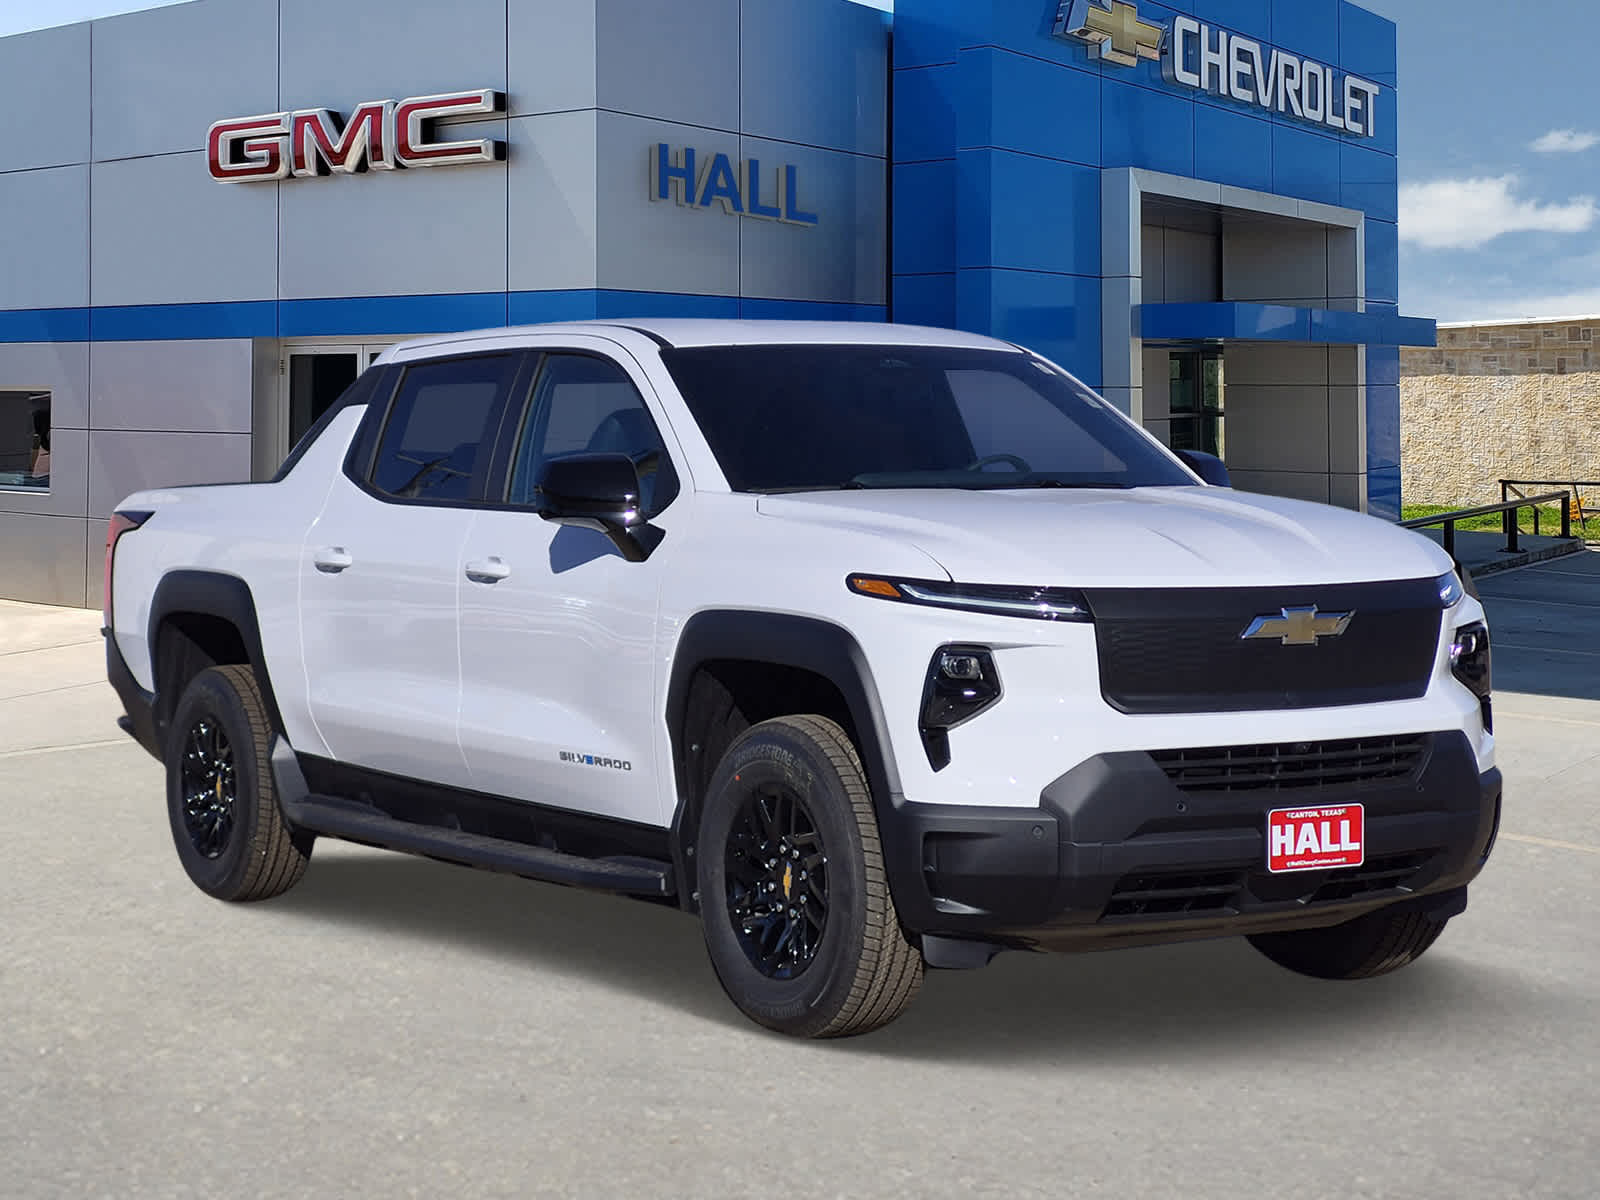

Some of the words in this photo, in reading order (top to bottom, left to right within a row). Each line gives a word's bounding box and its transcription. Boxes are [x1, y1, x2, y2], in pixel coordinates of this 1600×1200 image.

[1174, 15, 1380, 137] CHEVROLET
[208, 88, 502, 183] GMC
[655, 142, 818, 225] HALL
[559, 750, 632, 771] SILVERADO
[1271, 819, 1361, 857] HALL
[1321, 808, 1344, 817] TEXAS
